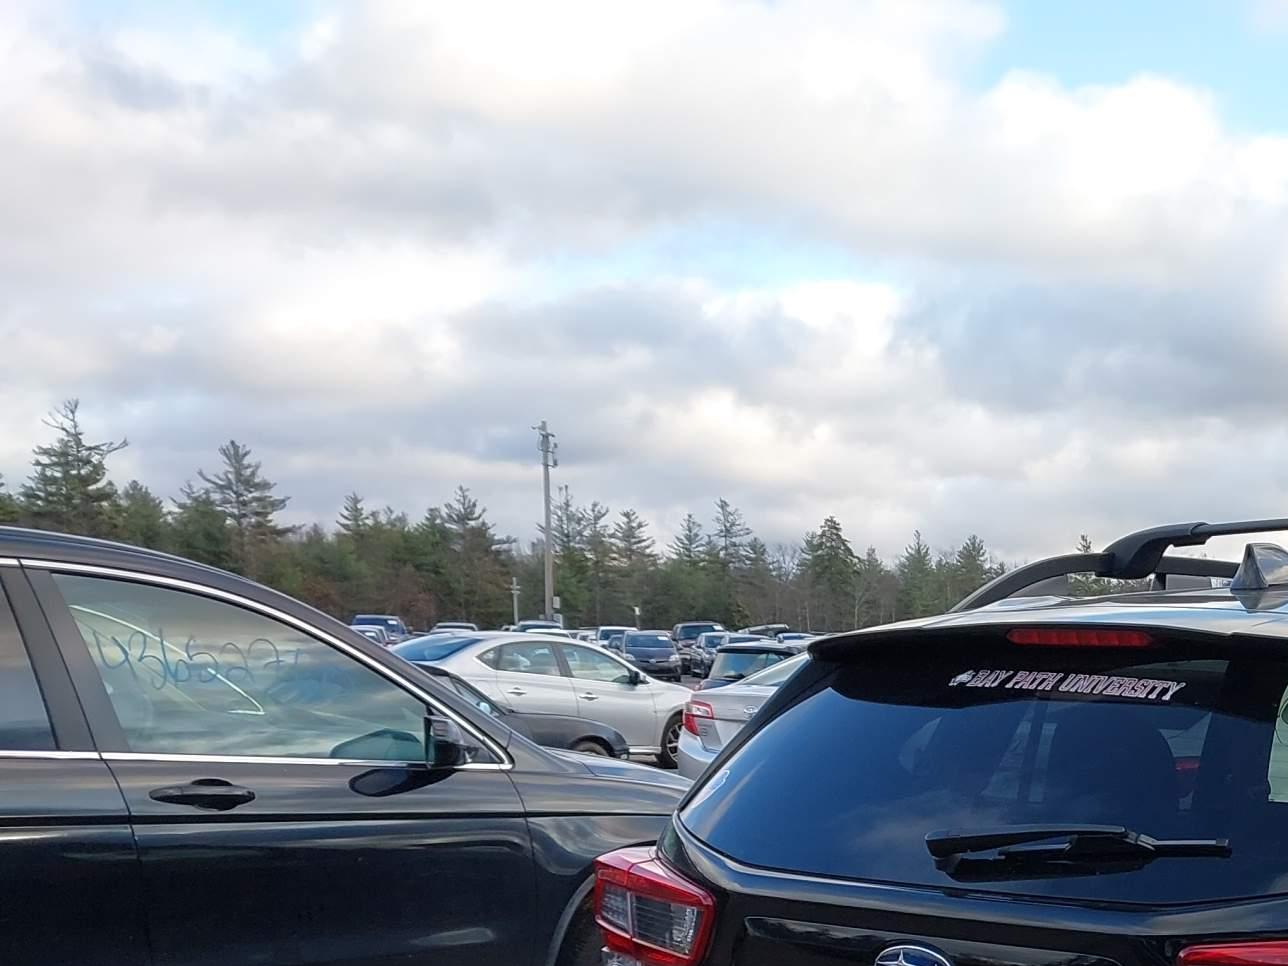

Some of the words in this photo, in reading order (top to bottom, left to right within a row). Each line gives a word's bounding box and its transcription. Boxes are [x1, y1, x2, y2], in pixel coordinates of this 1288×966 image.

[967, 670, 1014, 688] BAY
[1005, 671, 1064, 691] PATH
[1058, 673, 1187, 701] UNIVERSITY
